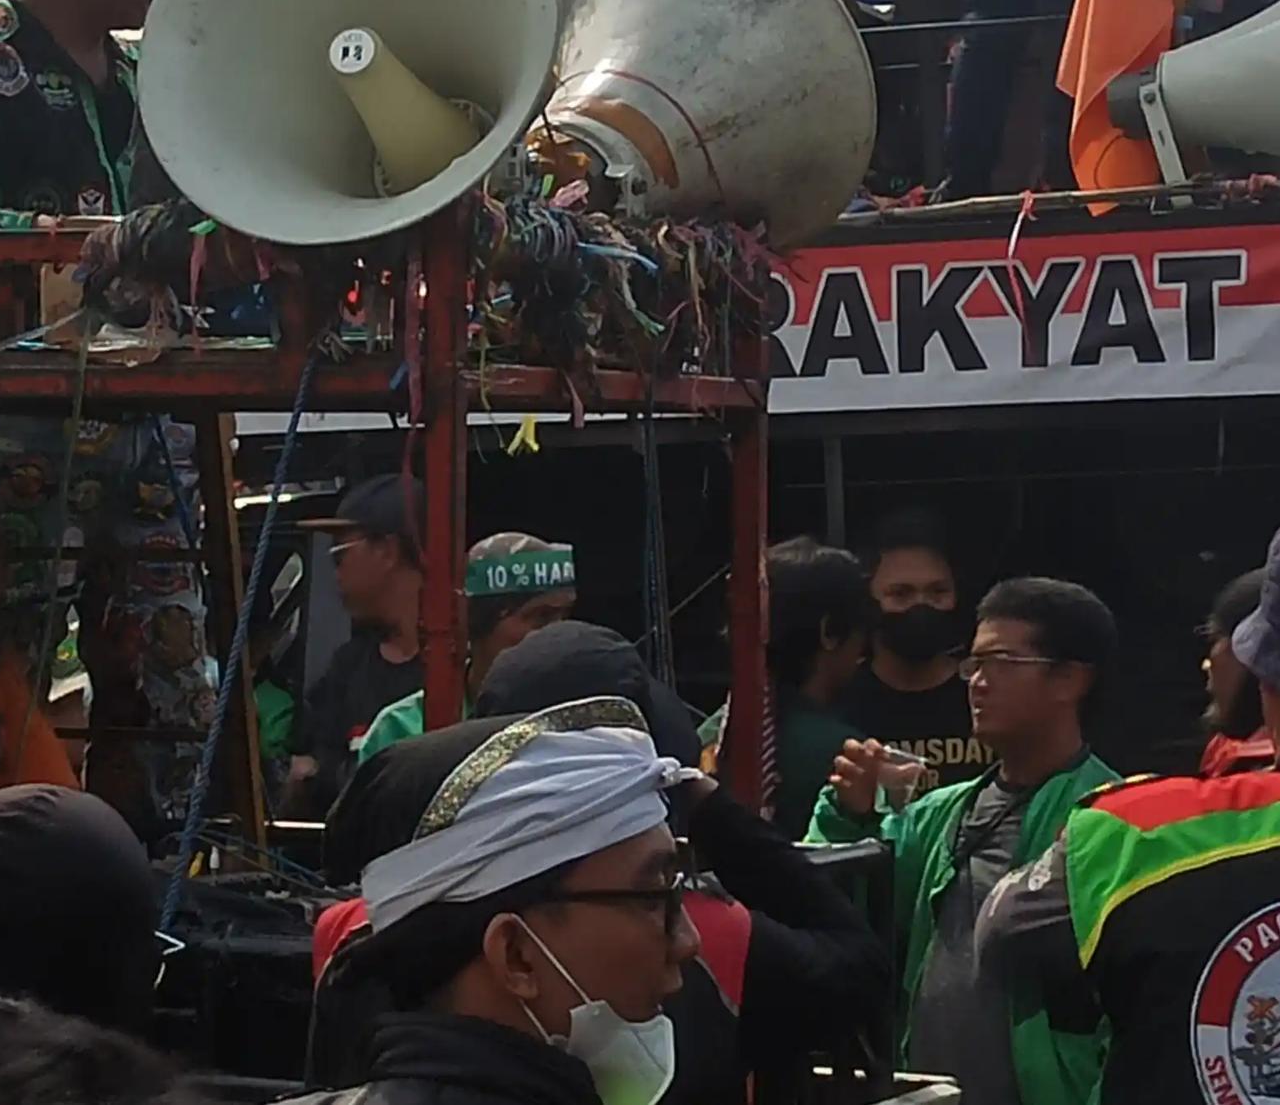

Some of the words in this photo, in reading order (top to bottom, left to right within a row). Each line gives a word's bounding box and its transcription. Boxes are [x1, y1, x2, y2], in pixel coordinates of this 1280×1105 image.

[486, 565, 508, 590] 10
[511, 562, 530, 586] %
[1204, 1055, 1243, 1105] SEN
